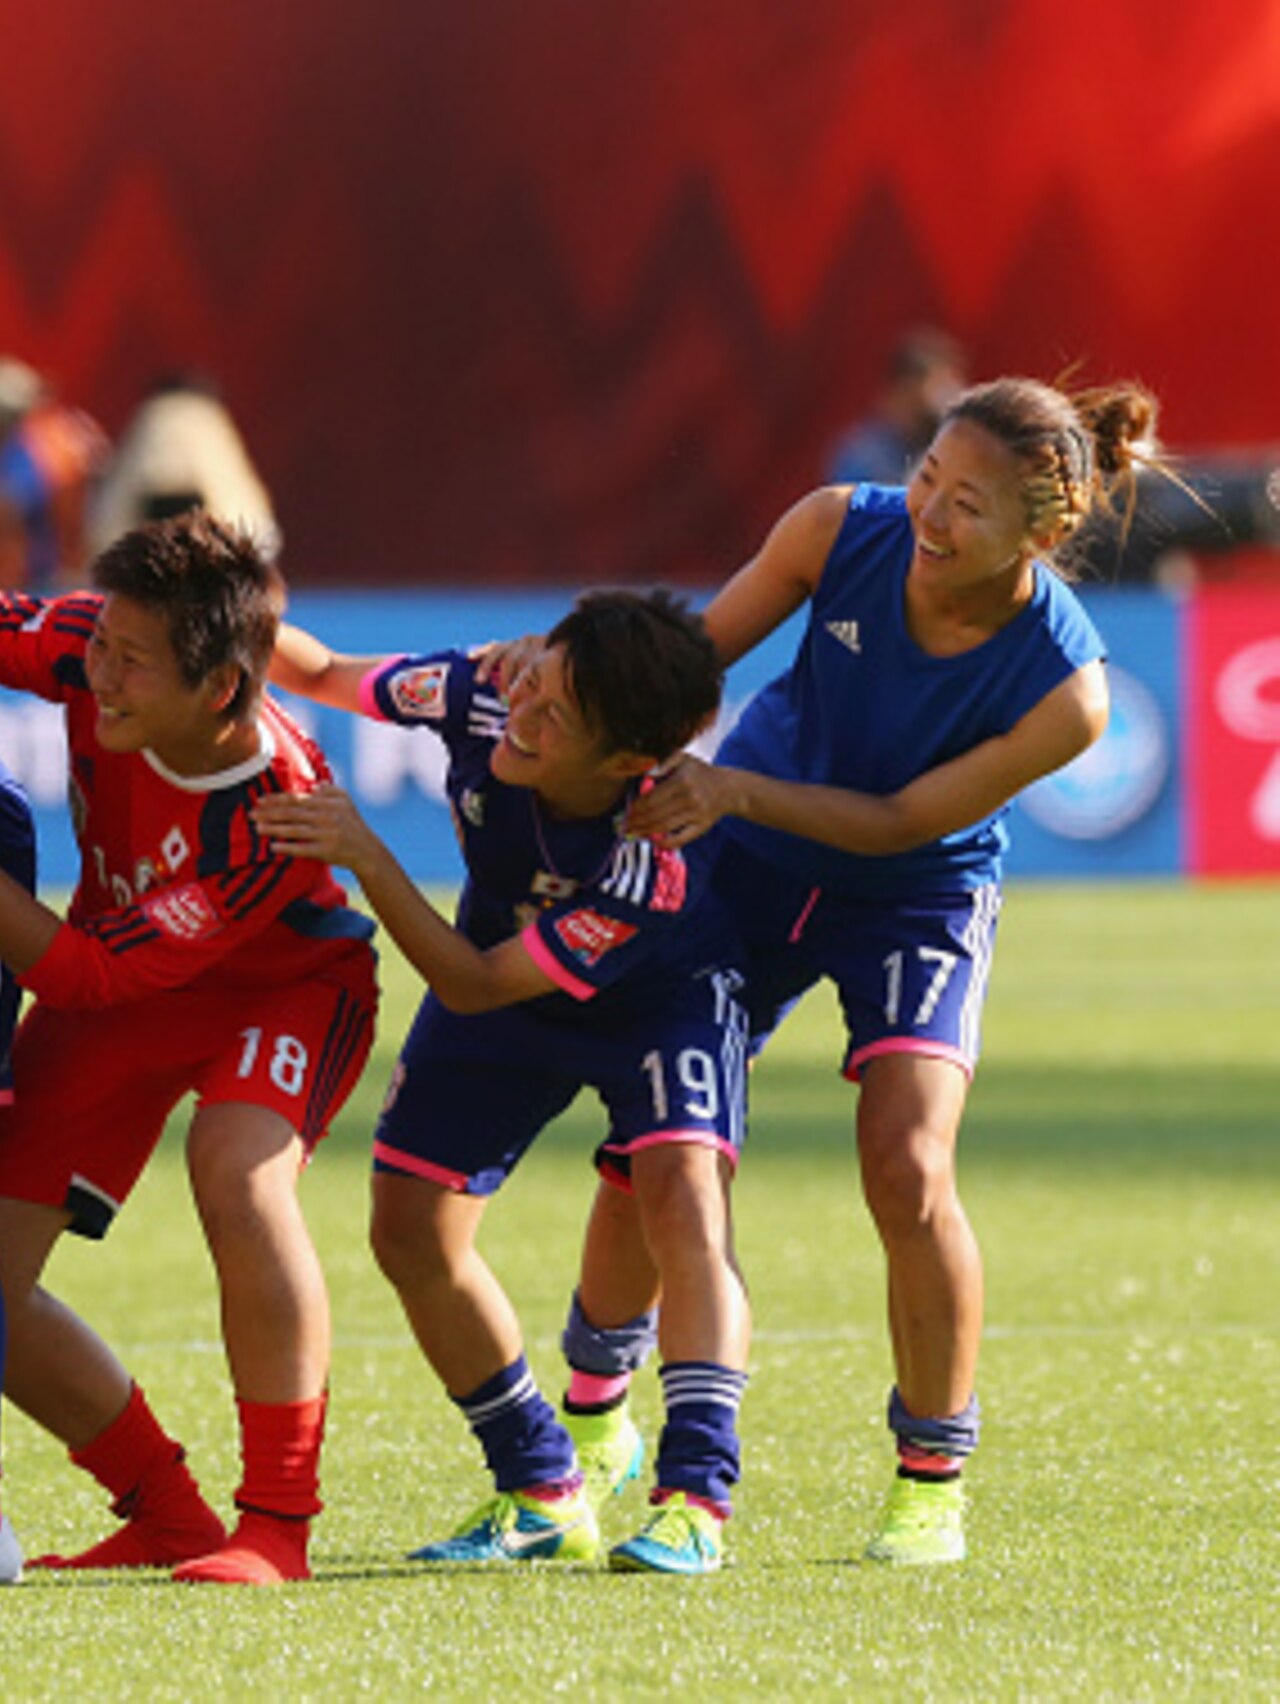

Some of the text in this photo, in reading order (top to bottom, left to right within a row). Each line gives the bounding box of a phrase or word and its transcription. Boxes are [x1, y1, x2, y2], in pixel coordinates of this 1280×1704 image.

[883, 946, 957, 1025] 17
[236, 1027, 307, 1095] 18
[641, 1048, 718, 1120] 19
